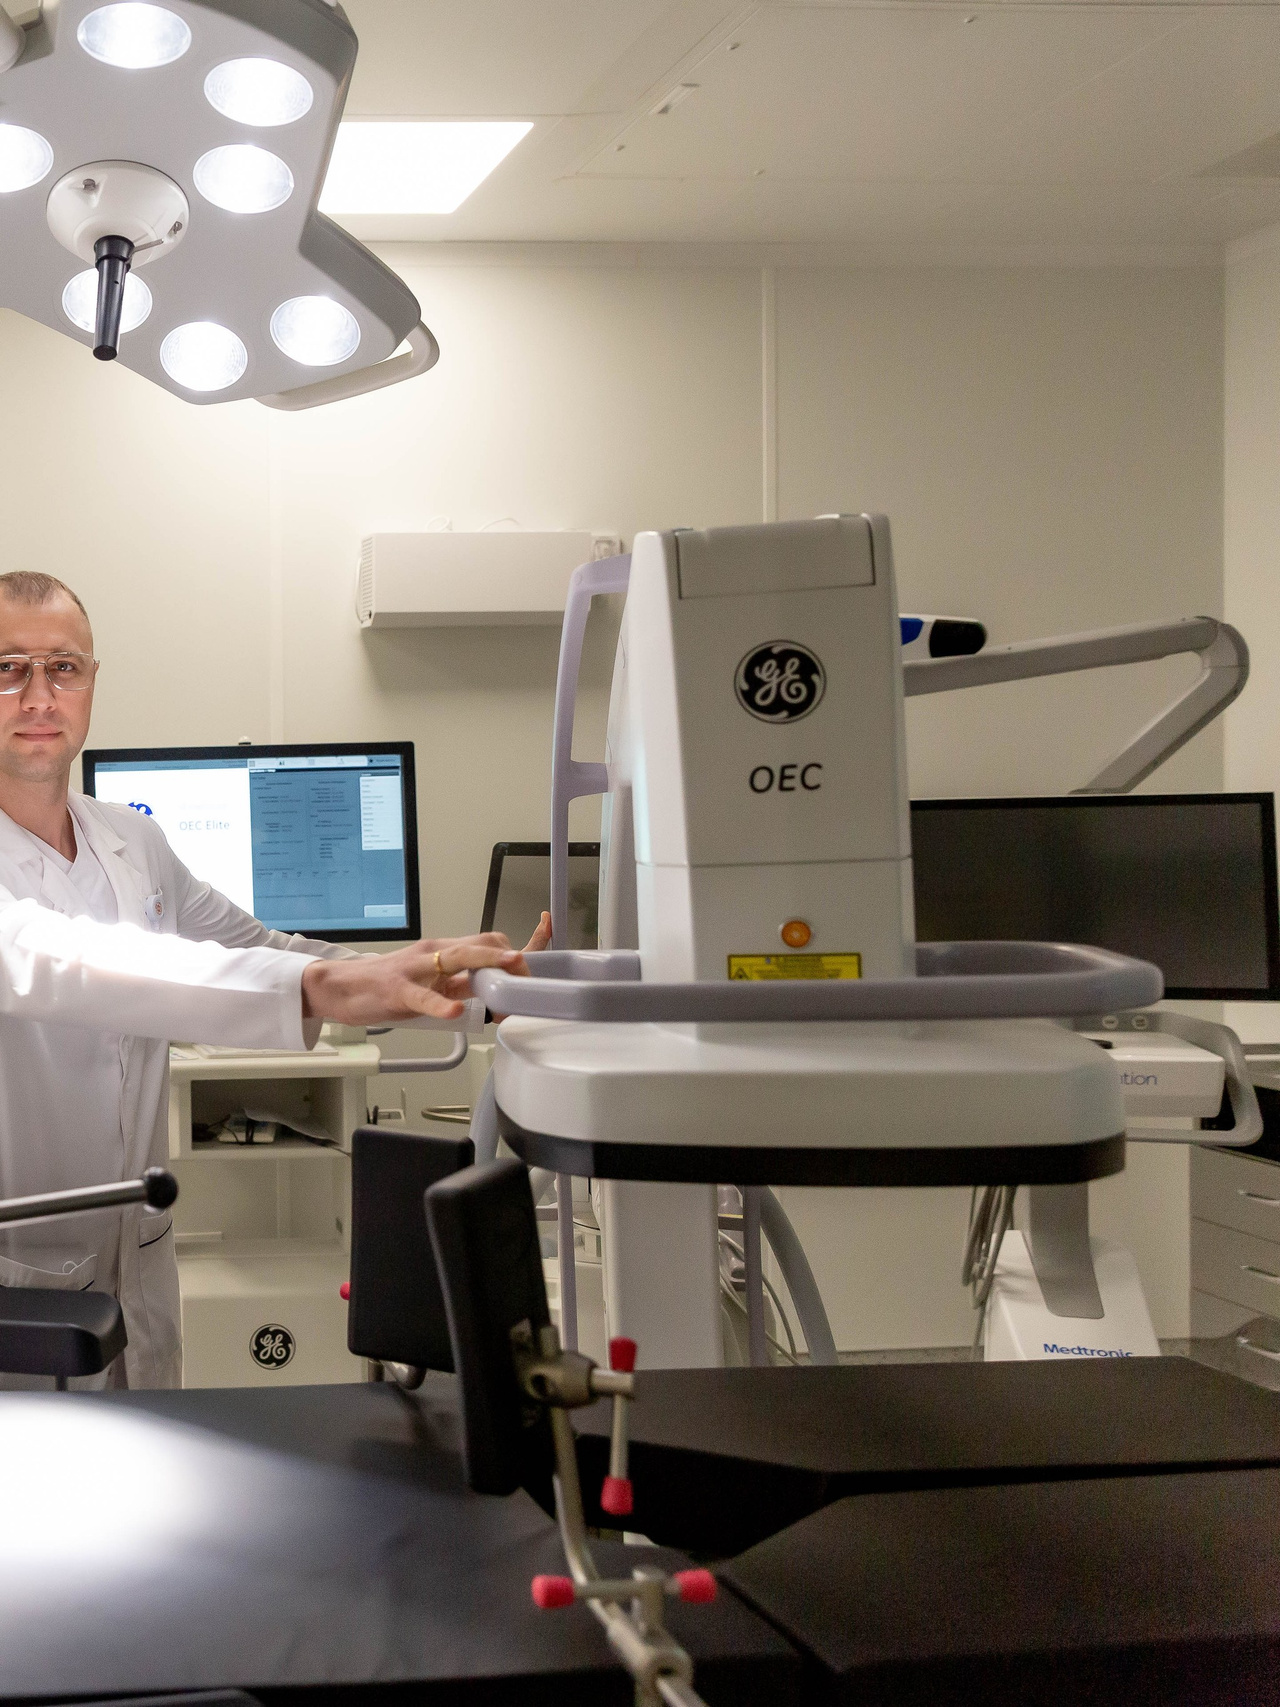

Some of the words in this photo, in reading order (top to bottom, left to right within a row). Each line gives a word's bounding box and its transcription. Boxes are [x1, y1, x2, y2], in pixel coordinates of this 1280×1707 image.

[749, 762, 823, 794] OEC
[179, 820, 202, 830] OEC
[206, 819, 230, 830] Elite
